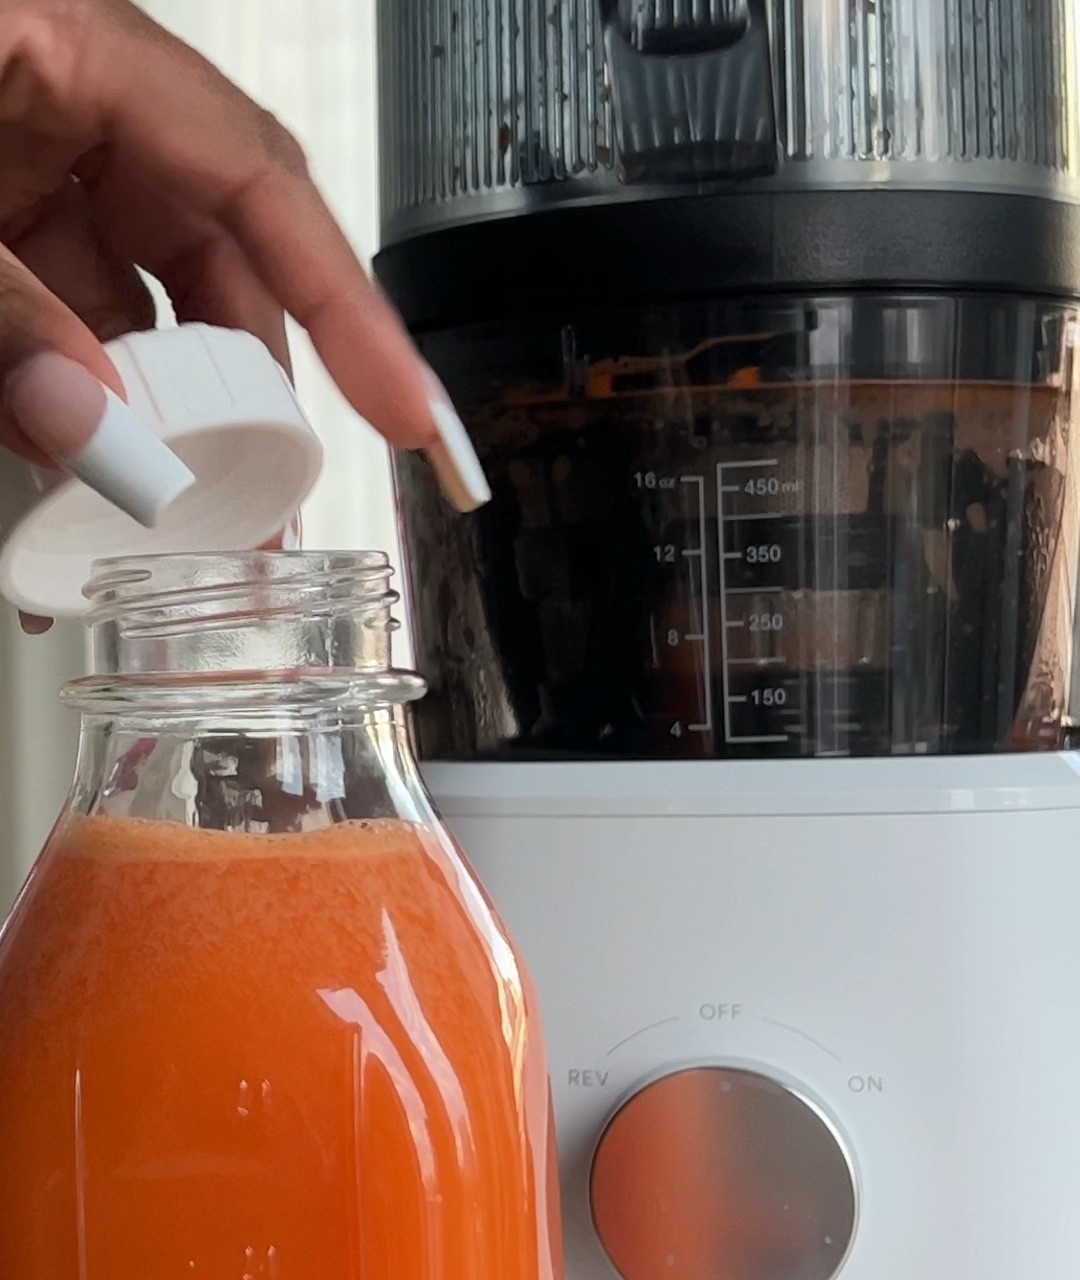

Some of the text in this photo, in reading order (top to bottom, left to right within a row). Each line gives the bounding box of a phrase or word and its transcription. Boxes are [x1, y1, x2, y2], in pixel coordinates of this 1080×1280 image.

[633, 471, 676, 490] 16 oz
[743, 477, 800, 496] 450 ml
[653, 544, 676, 563] 12
[746, 545, 781, 563] 350
[748, 613, 784, 632] 250
[666, 628, 679, 647] 8
[751, 687, 787, 706] 150
[669, 720, 682, 738] 4
[698, 1003, 743, 1021] OFF
[567, 1069, 610, 1088] REV
[847, 1075, 884, 1093] ON
